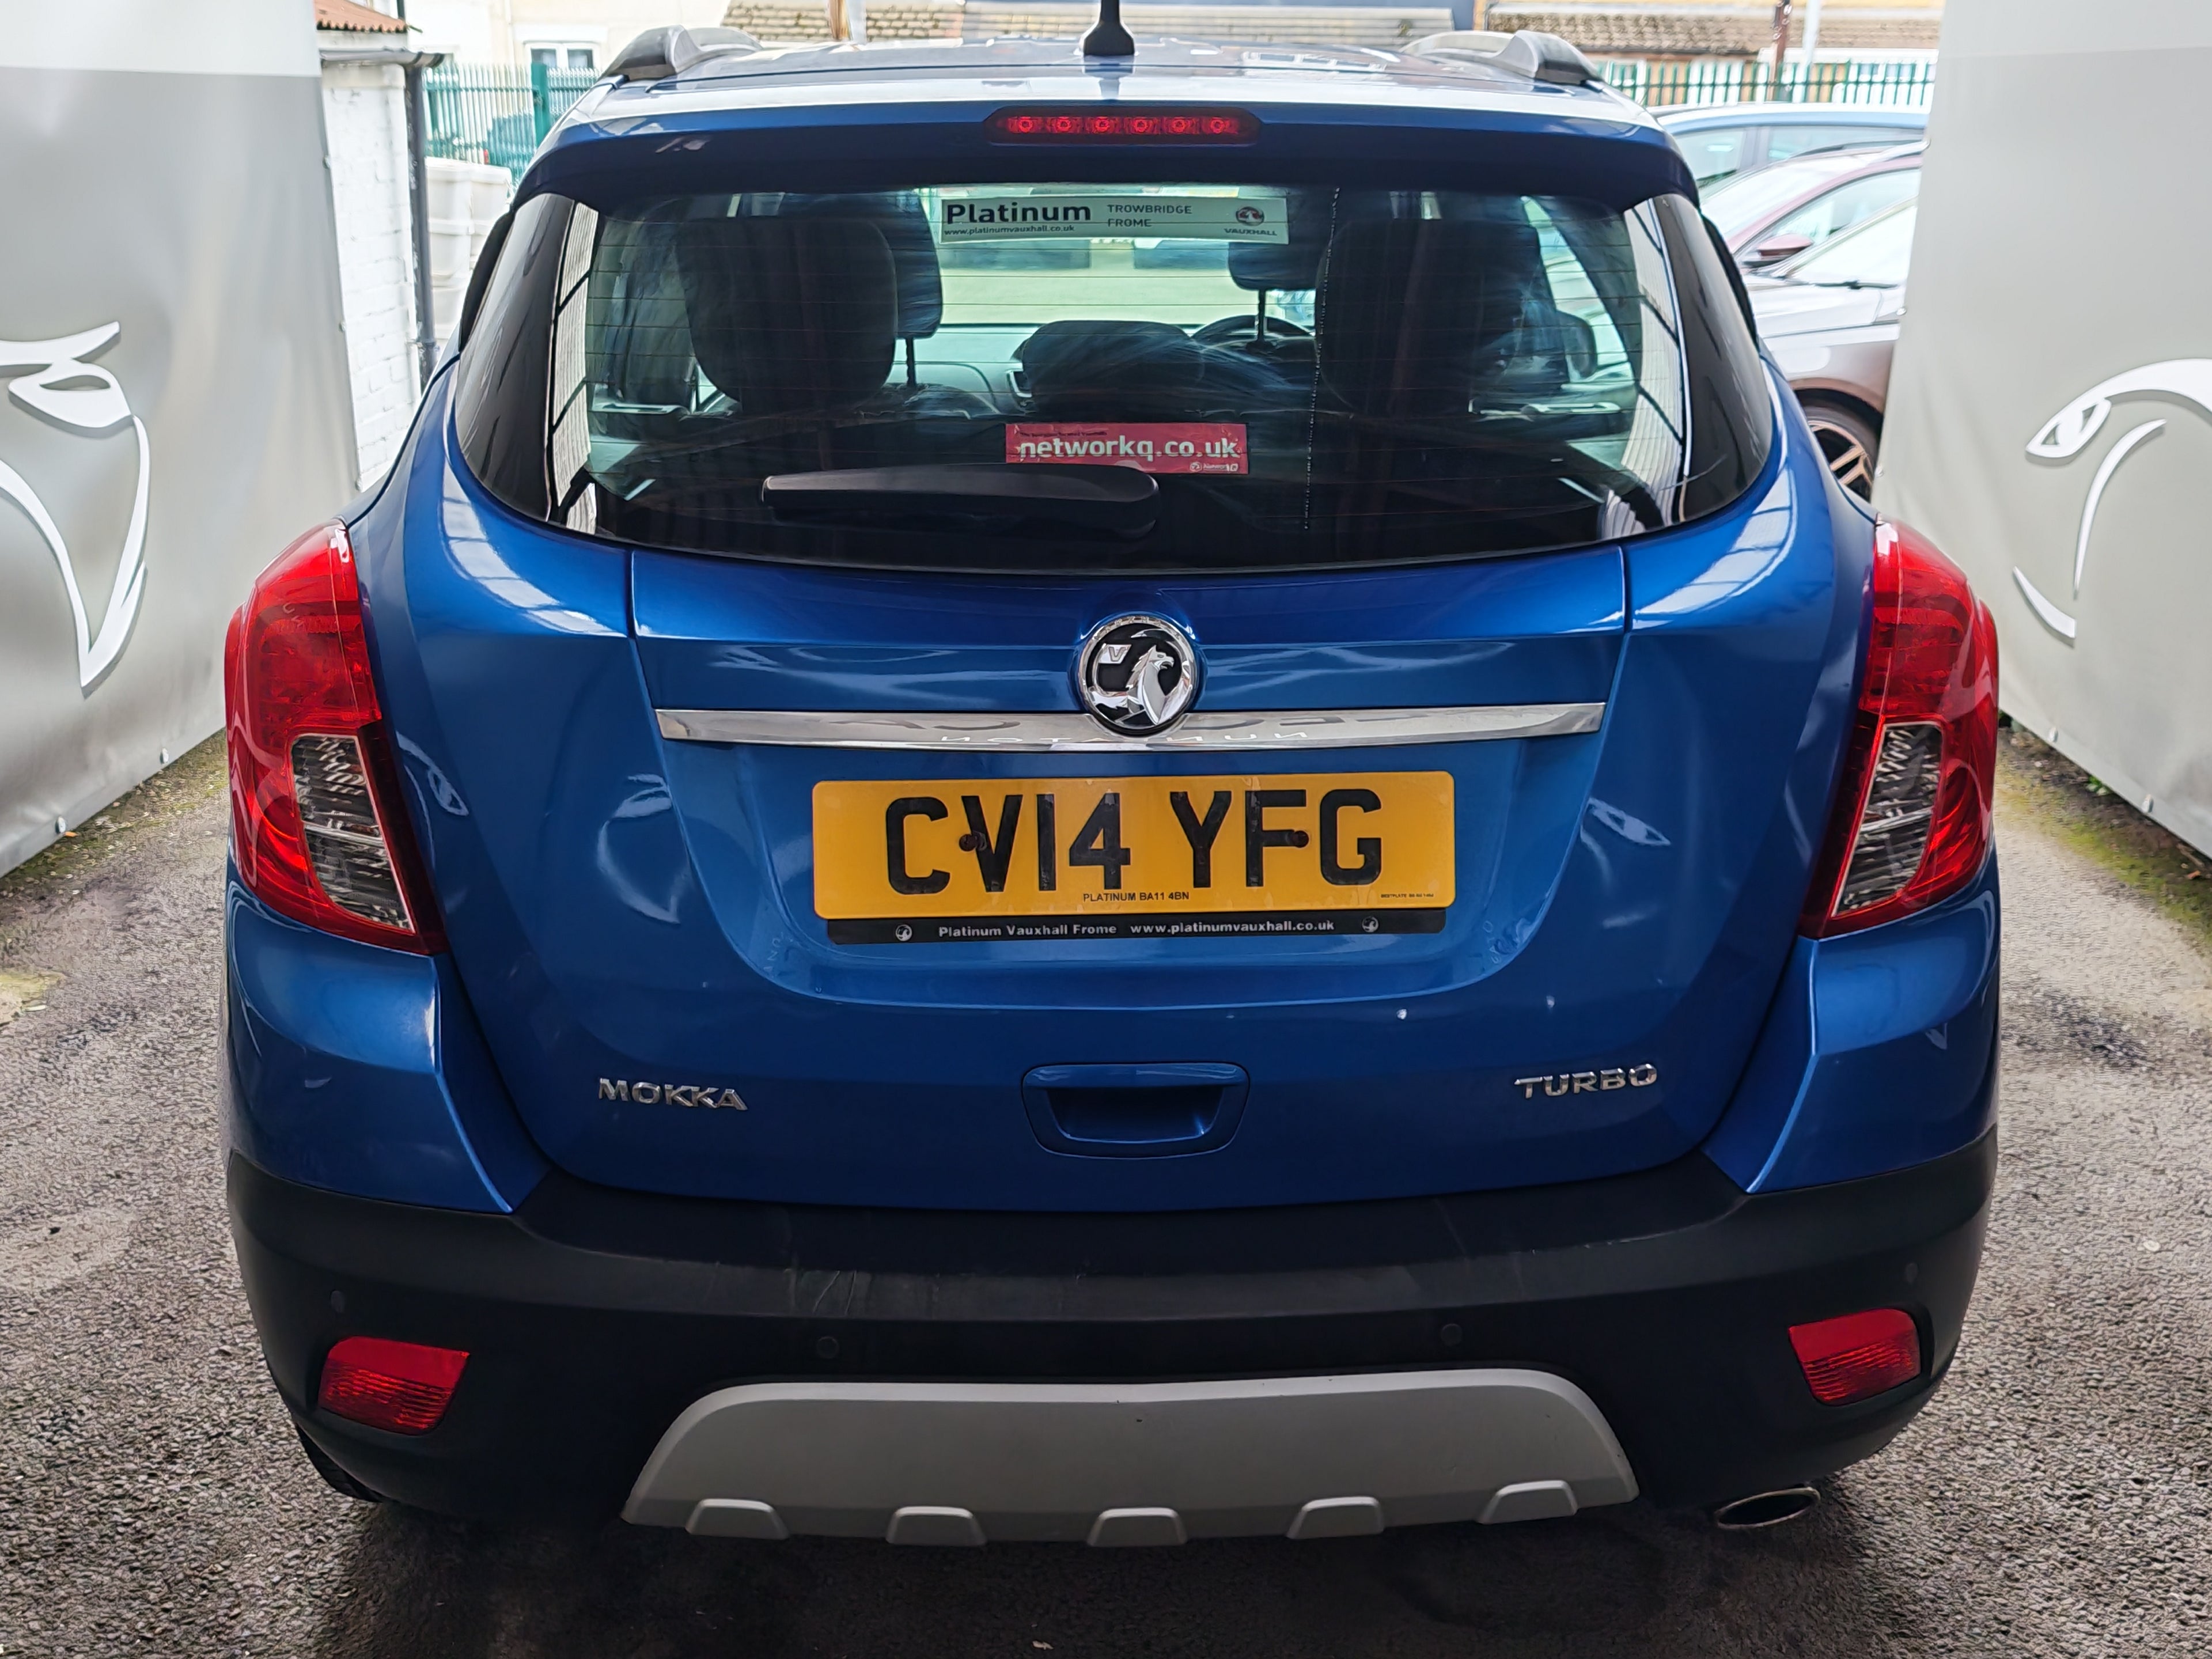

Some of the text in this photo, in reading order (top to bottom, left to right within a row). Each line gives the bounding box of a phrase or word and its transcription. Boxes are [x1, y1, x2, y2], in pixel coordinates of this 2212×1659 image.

[946, 202, 1092, 225] Platinum
[1107, 203, 1192, 215] TROWBRIDGE
[944, 225, 1075, 236] www.platinumvauxhall.co.uk
[1107, 218, 1152, 228] FROME
[1224, 228, 1278, 236] VAUXHALL
[1020, 435, 1241, 462] networkq.co.uk
[885, 789, 1382, 895] CV14 YFG
[1083, 892, 1190, 902] PLATINUM BA11 4BN
[938, 919, 1335, 937] Platinum Vauxhall Frome www.platinumvauxhall.co.uk
[1514, 1064, 1658, 1099] TURBO
[599, 1078, 748, 1111] MOKKA
